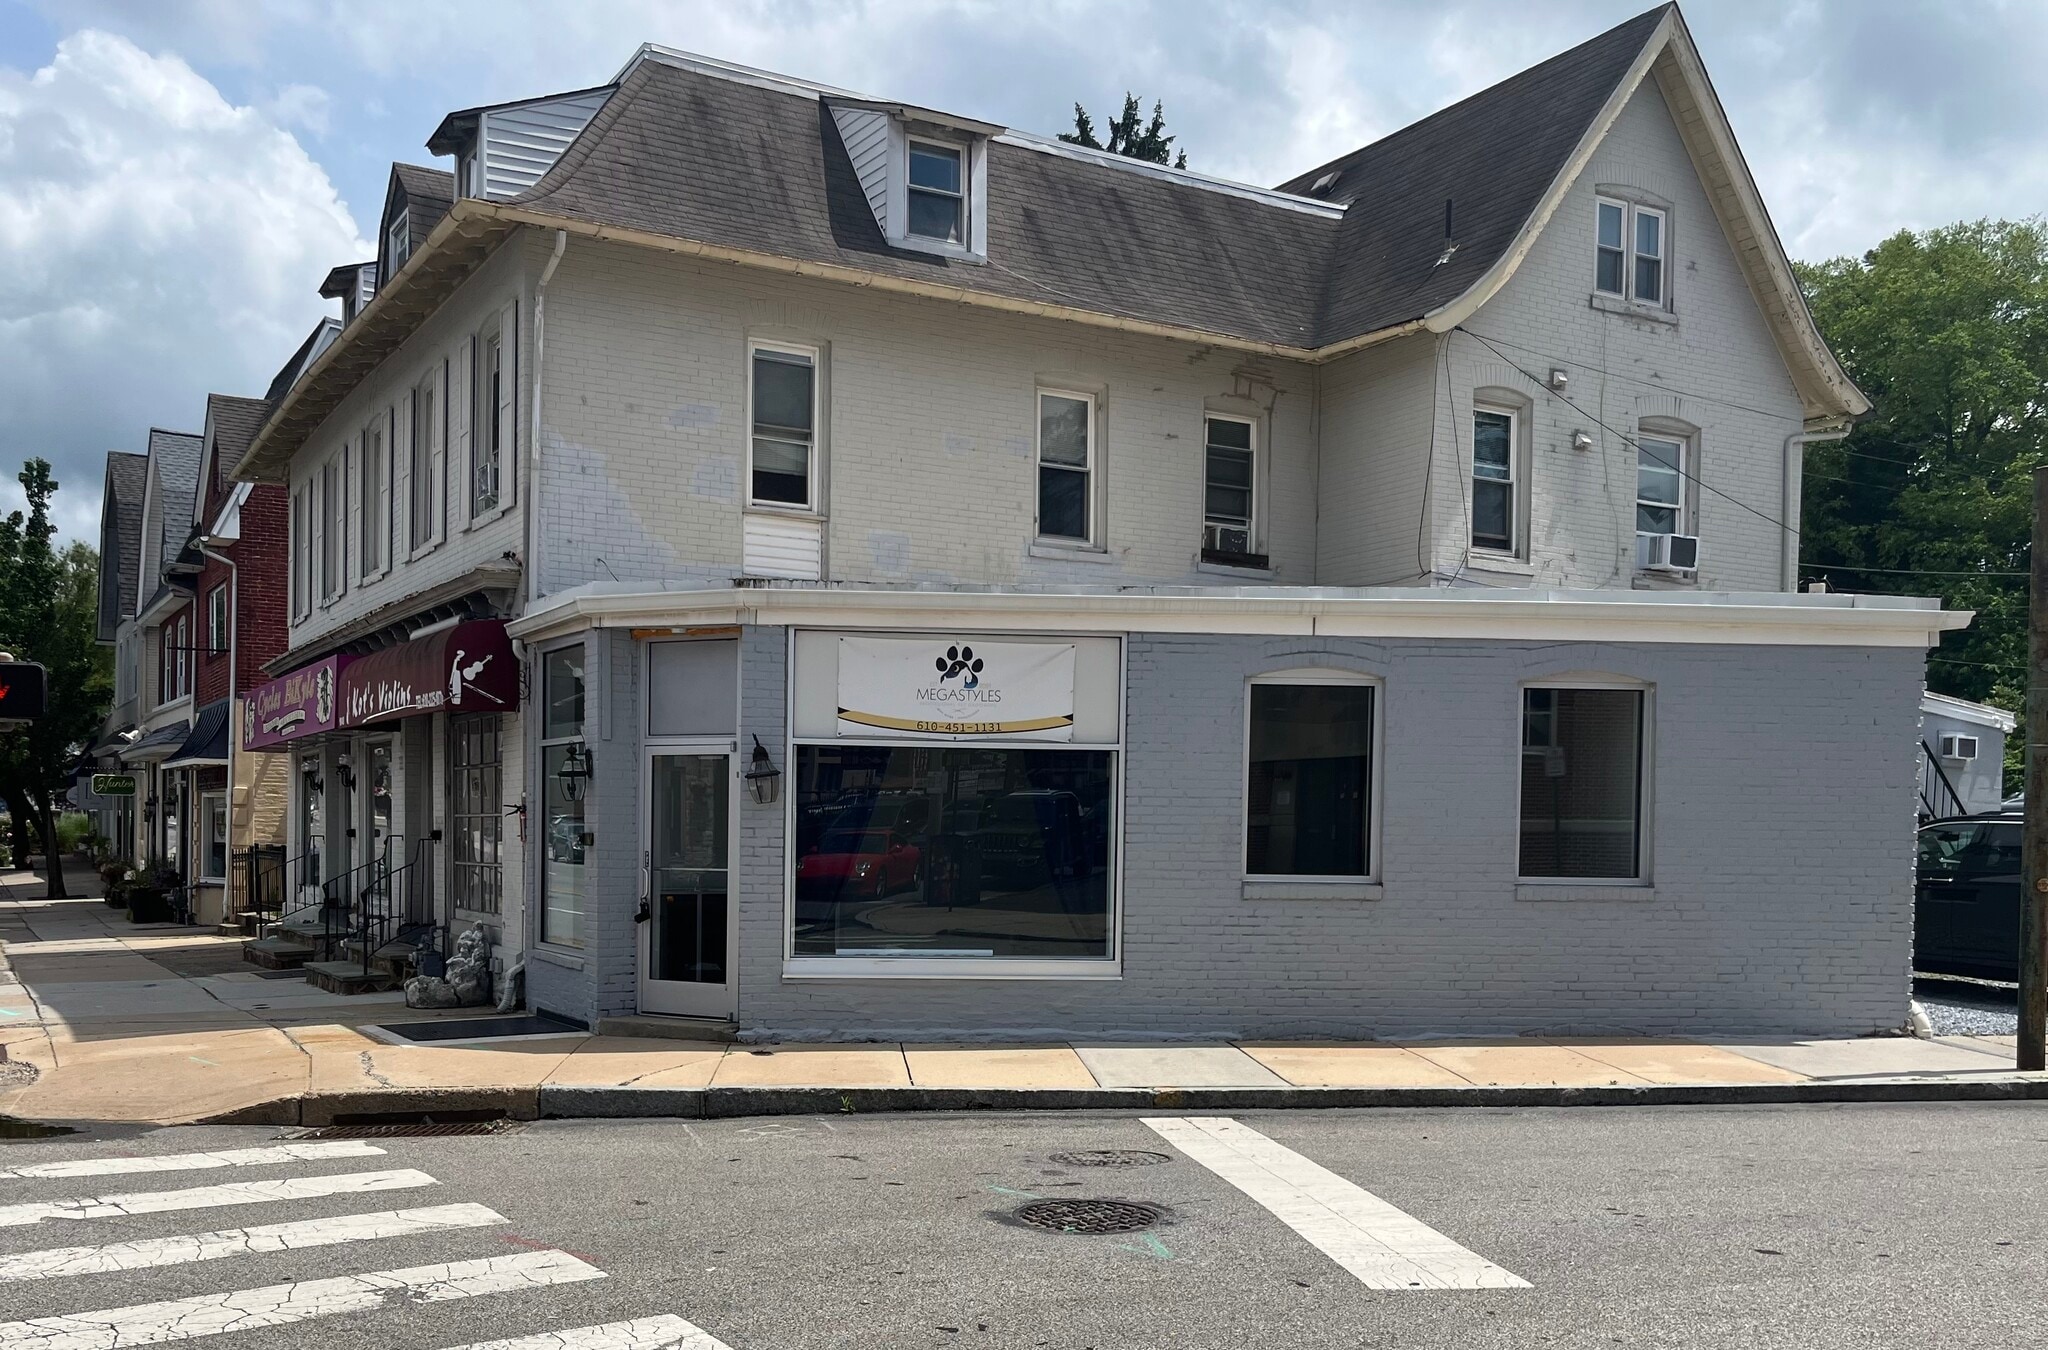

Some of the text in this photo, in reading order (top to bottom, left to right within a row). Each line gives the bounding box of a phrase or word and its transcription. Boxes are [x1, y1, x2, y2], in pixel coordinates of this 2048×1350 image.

[378, 680, 411, 711] Violins
[916, 687, 1002, 703] MEGASTYLES
[916, 721, 1002, 732] 610-451-1131
[95, 777, 135, 792] Hunter
